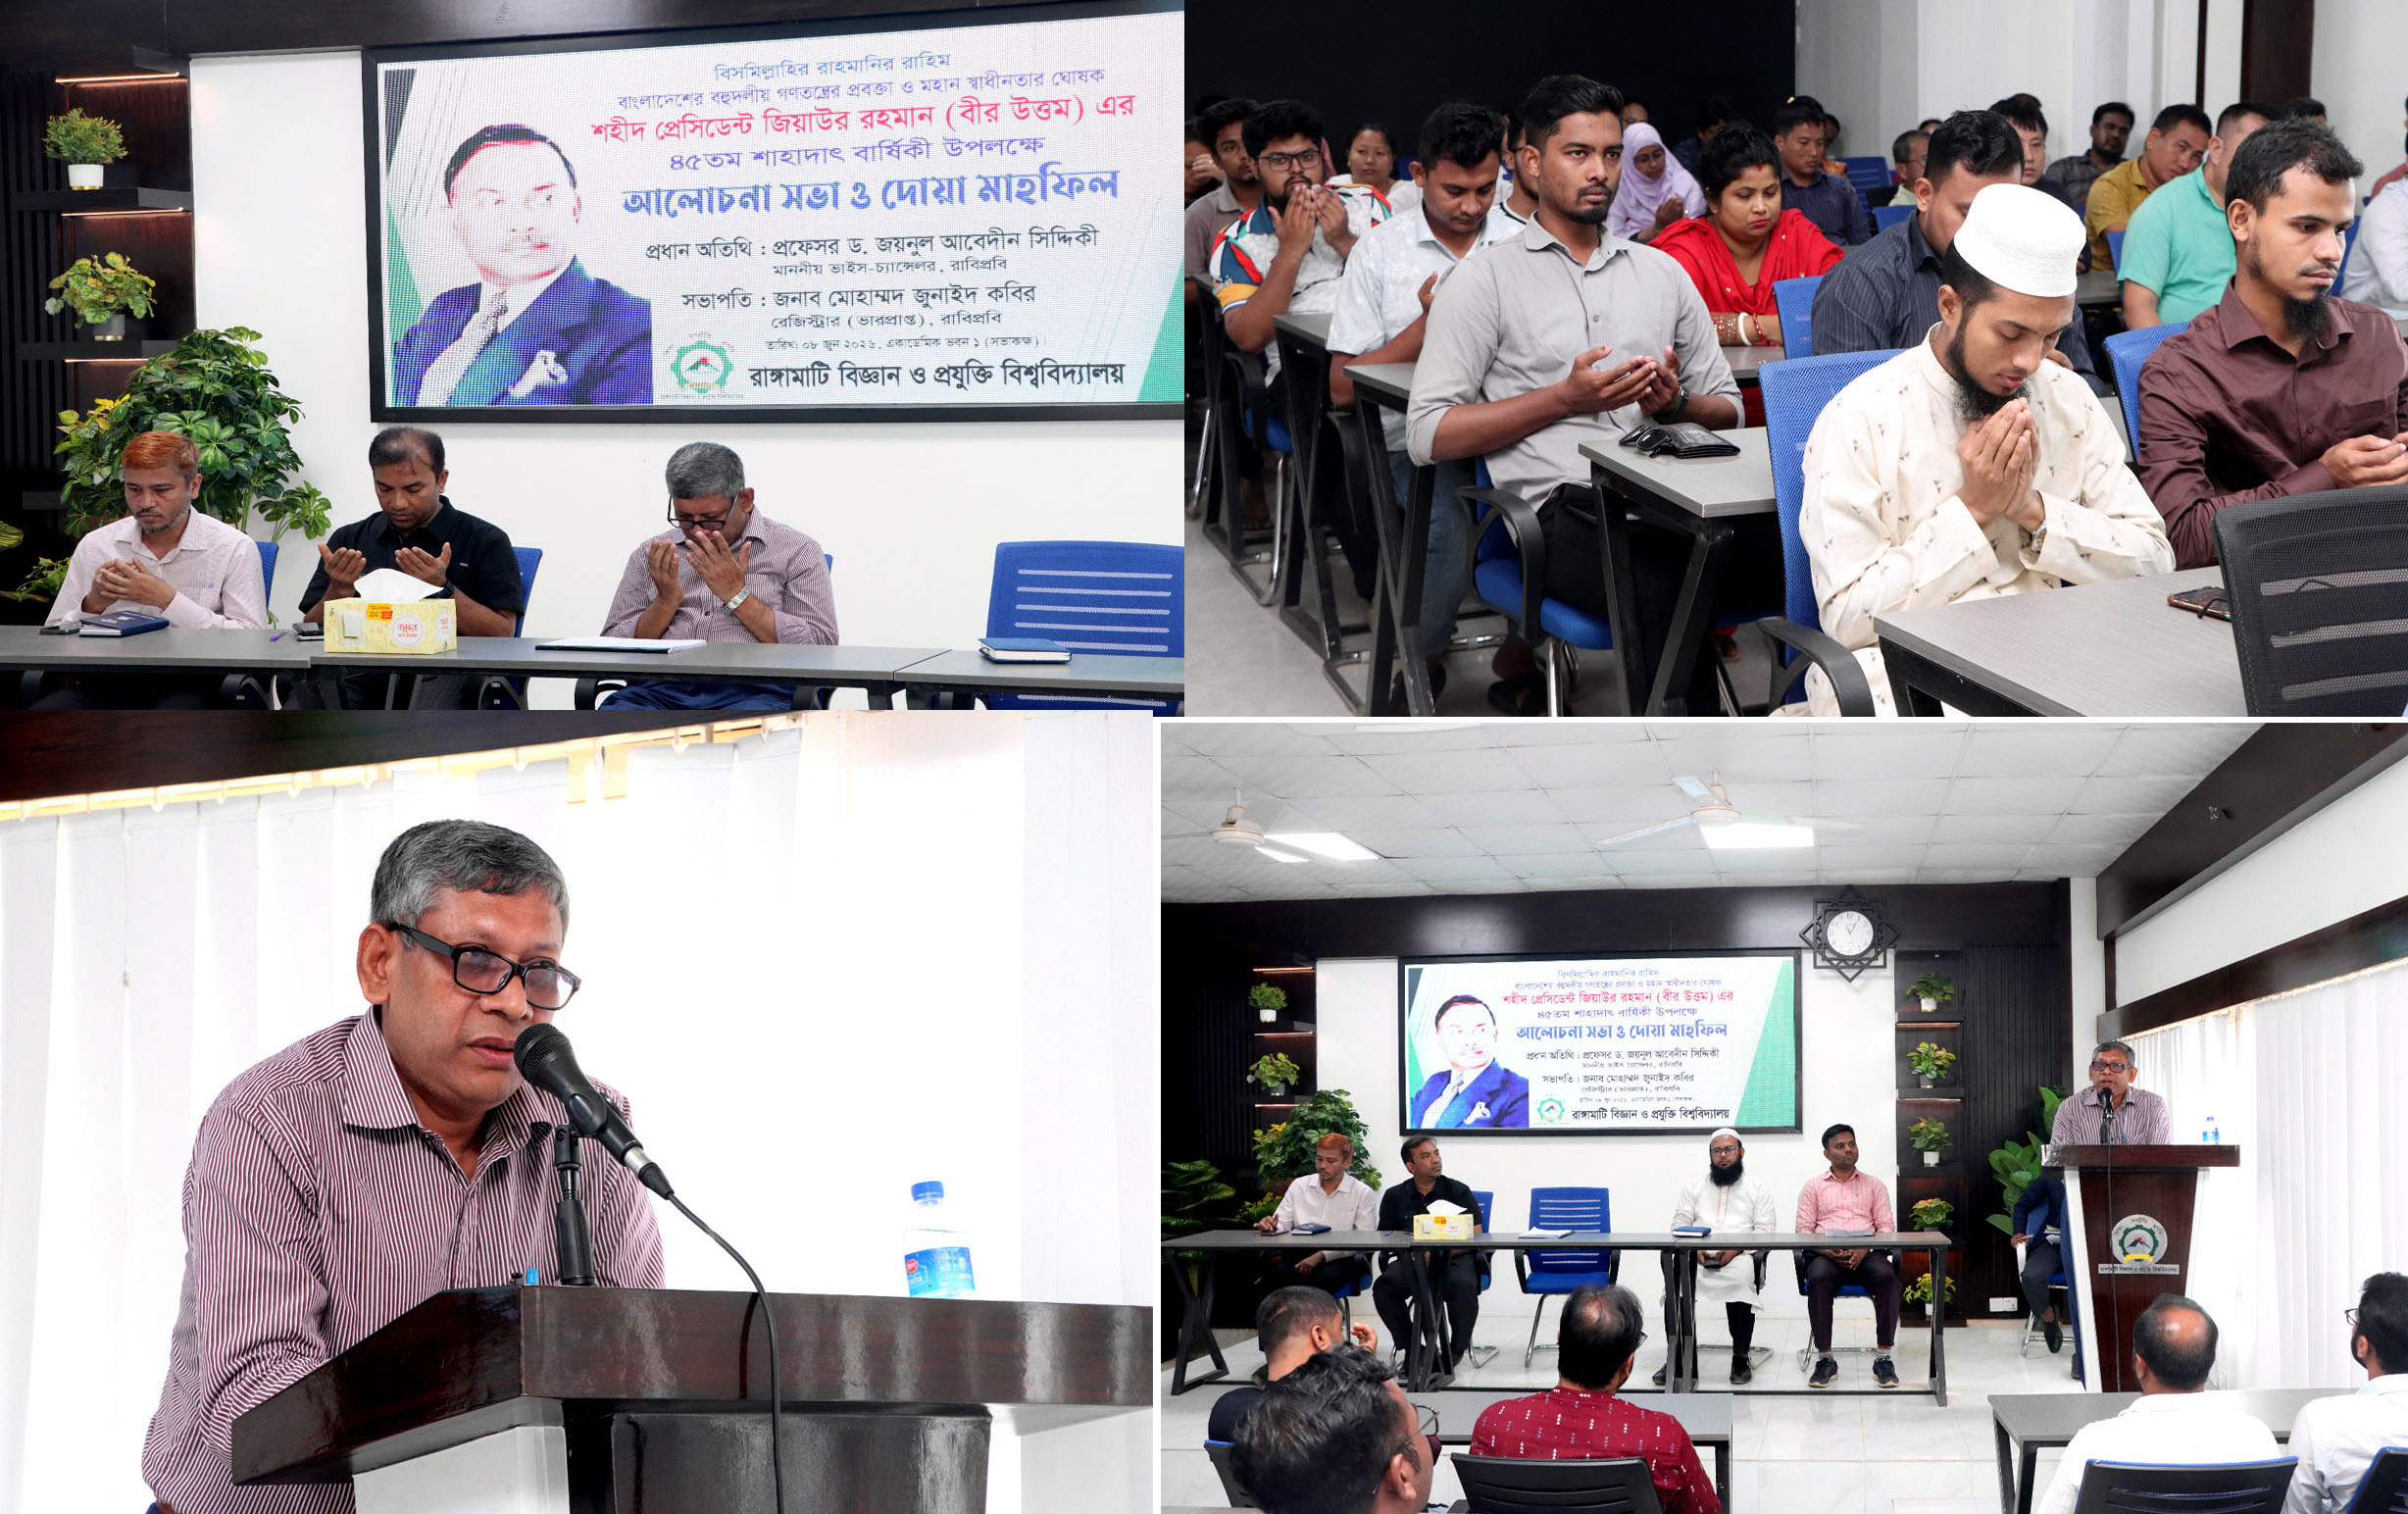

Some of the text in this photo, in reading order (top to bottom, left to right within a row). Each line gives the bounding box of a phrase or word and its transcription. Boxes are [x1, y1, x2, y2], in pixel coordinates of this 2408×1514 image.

[715, 51, 951, 79] বিসমিল্লাহির রাহমানির রাহিম
[618, 69, 1105, 109] বাংলাদেশের বহুদলীয় গণতন্ত্রের প্রবক্তা ও মহান স্বাধীনতার ঘোষক
[591, 94, 1136, 142] শহীদ প্রেসিডেন্ট জিয়াউর রহমান (বীর উত্তম) এর
[671, 136, 1046, 171] ৪৫তম শাহাদাৎ বার্ষিকী উপলক্ষে
[623, 161, 1120, 217] আলোচনা সভা ও দোয়া মাহফিল
[646, 243, 690, 260] প্রধান
[695, 236, 752, 258] অতিথি
[773, 238, 839, 257] প্রফেসর
[847, 237, 868, 255] ড.
[876, 235, 934, 256] জয়নুল
[939, 227, 1022, 251] আবেদীন
[1029, 225, 1099, 248] সিদ্দিকী
[773, 261, 823, 276] মাননীয়
[950, 255, 1007, 273] রাবিপ্রবি
[682, 287, 752, 309] সভাপতি
[774, 291, 822, 308] জনাব
[828, 288, 905, 307] মোহাম্মদ
[912, 283, 978, 310] জুনাইদ
[986, 280, 1036, 302] কবির
[941, 309, 1002, 326] রাবিপ্রবি
[749, 358, 1126, 392] রাঙ্গামাটি বিজ্ঞান ও প্রযুক্তি বিশ্ববিদ্যালয়
[1503, 992, 1527, 1005] শহীদ
[1531, 991, 1575, 1004] প্রেসিডেন্ট
[1579, 990, 1617, 1003] জিয়াউর
[1621, 993, 1652, 1002] রহমান
[1656, 988, 1680, 1004] (বীর
[1718, 990, 1733, 1001] এর
[1618, 1007, 1650, 1017] বার্ষিকী
[1656, 1007, 1697, 1017] উপলক্ষে
[1516, 1019, 1727, 1041] আলোচনা সভা ও দোয়া মাহফিল
[1549, 1049, 1574, 1059] অতিথি
[1655, 1048, 1687, 1058] আবেদীন
[1690, 1047, 1719, 1058] সিদ্দিকী
[1542, 1074, 1574, 1084] সভাপতি
[1674, 1072, 1694, 1082] কবির
[1572, 1108, 1730, 1121] রাঙ্গামাটি বিজ্ঞান ও প্রযুক্তি বিশ্ববিদ্যালয়
